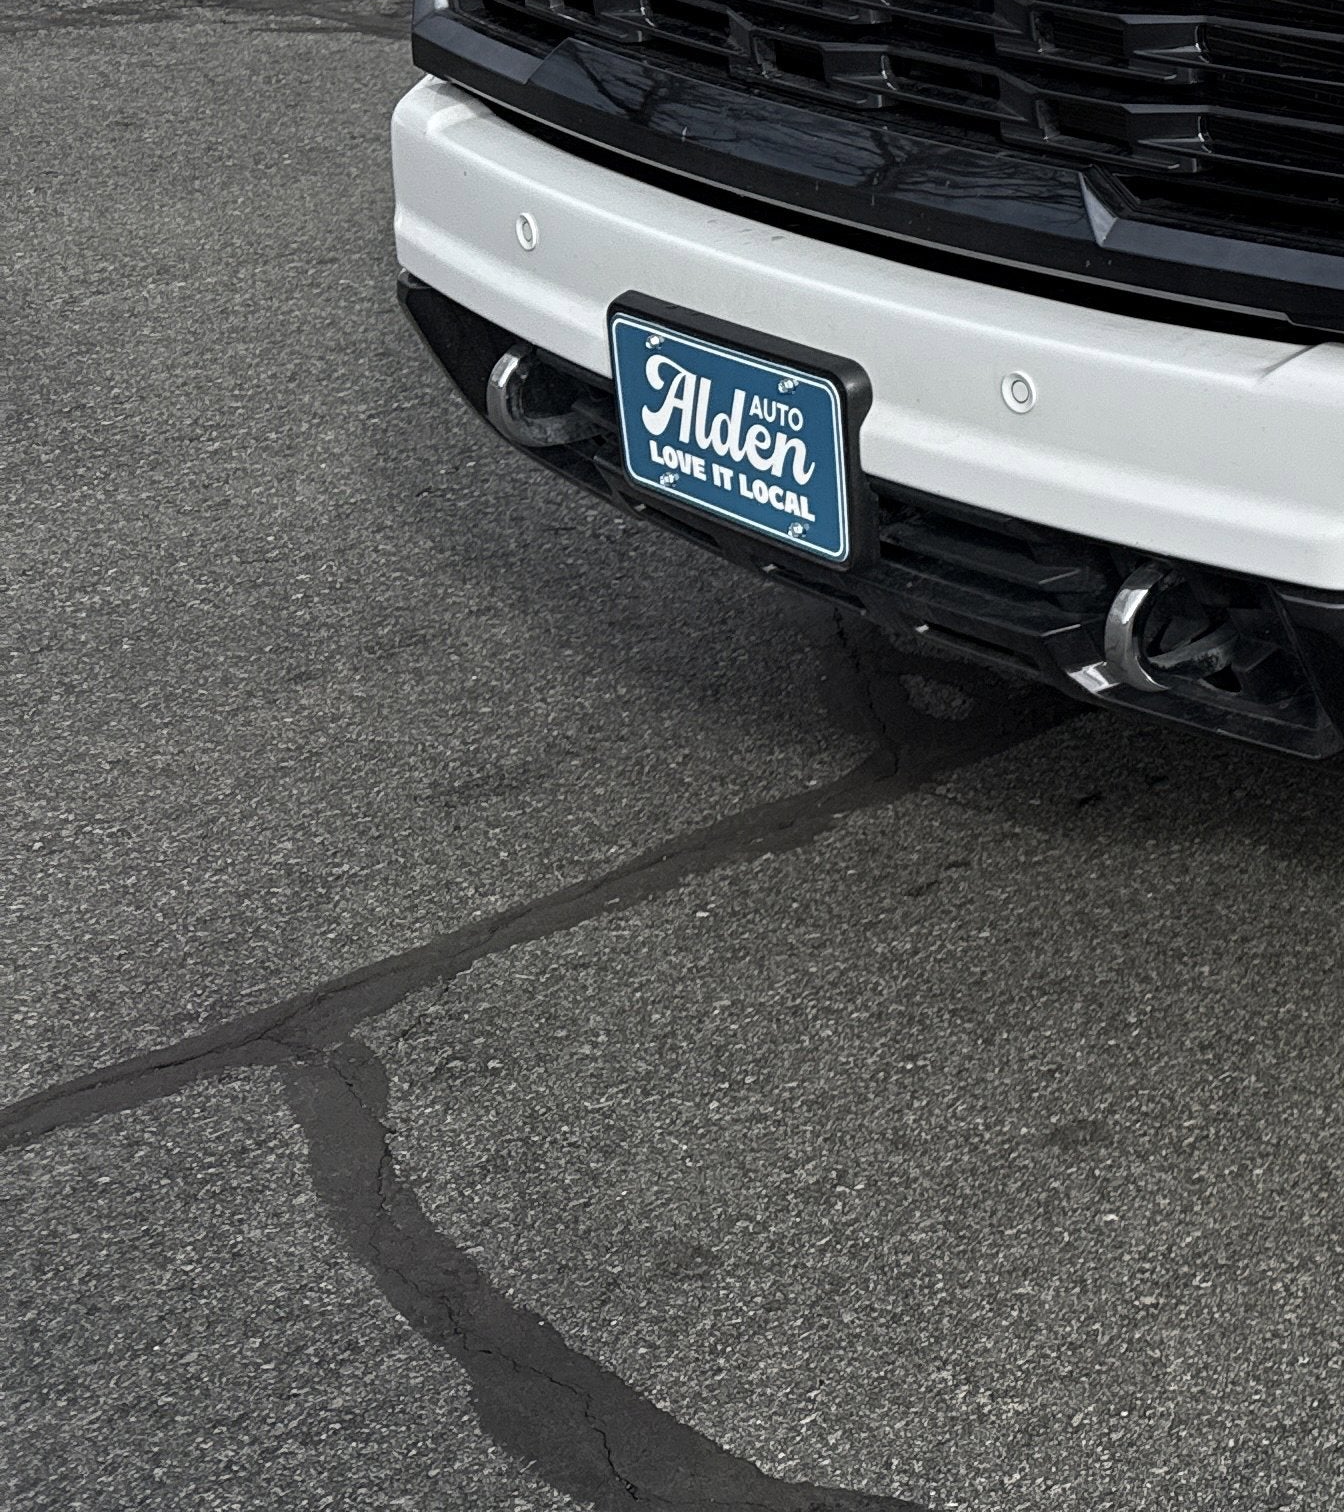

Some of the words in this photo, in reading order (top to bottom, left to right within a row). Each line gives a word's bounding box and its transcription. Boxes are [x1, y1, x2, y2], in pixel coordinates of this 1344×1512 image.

[641, 354, 816, 486] Alden
[749, 394, 804, 432] AUTO
[649, 439, 707, 482] LOVE
[712, 463, 735, 492] IT
[739, 472, 816, 523] LOCAL
